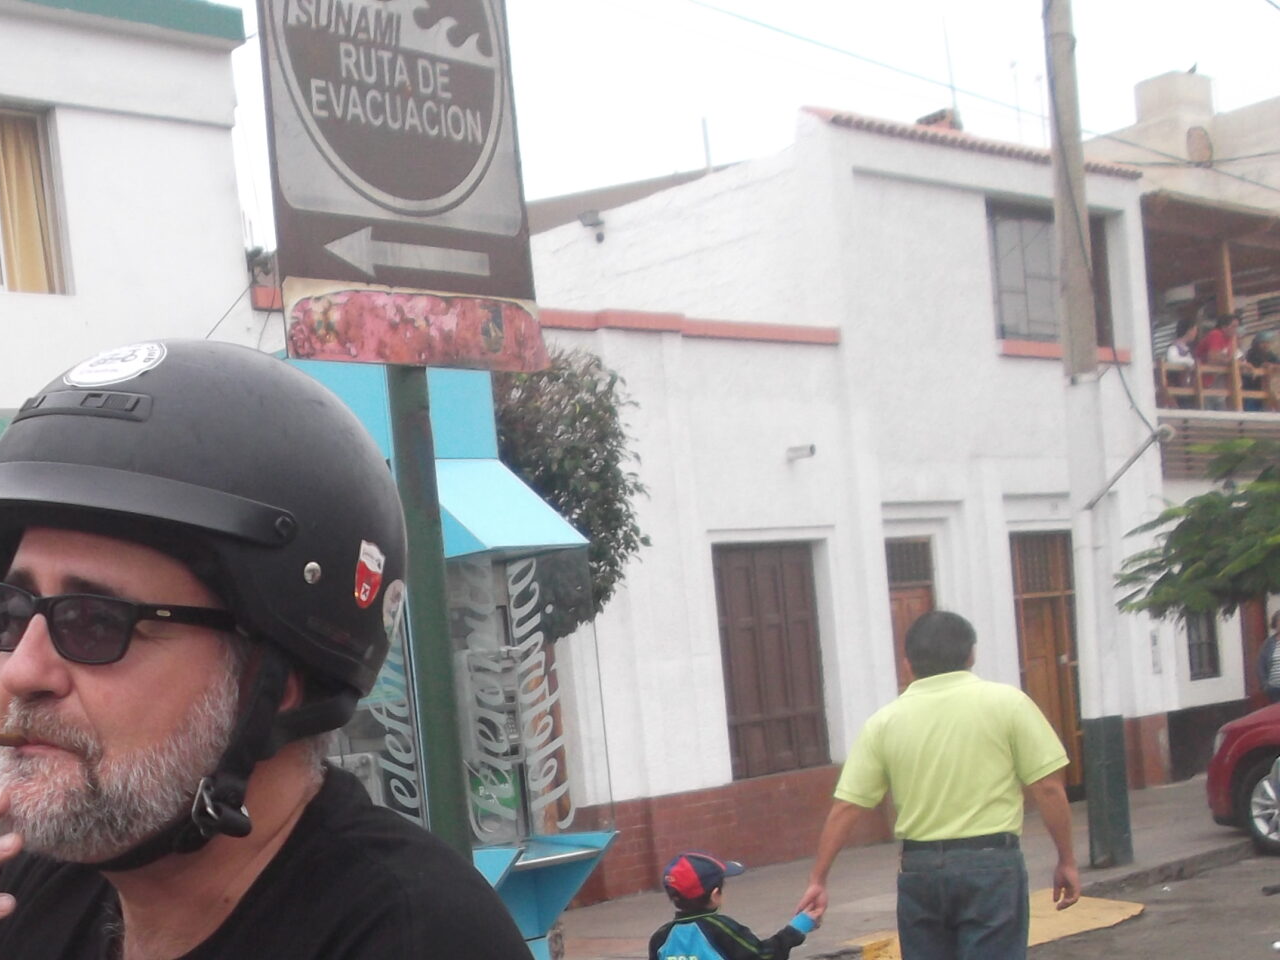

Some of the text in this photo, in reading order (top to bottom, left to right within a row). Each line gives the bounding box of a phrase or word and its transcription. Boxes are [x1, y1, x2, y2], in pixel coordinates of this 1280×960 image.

[339, 42, 452, 100] RUTA DE
[310, 78, 484, 145] EVACUACION
